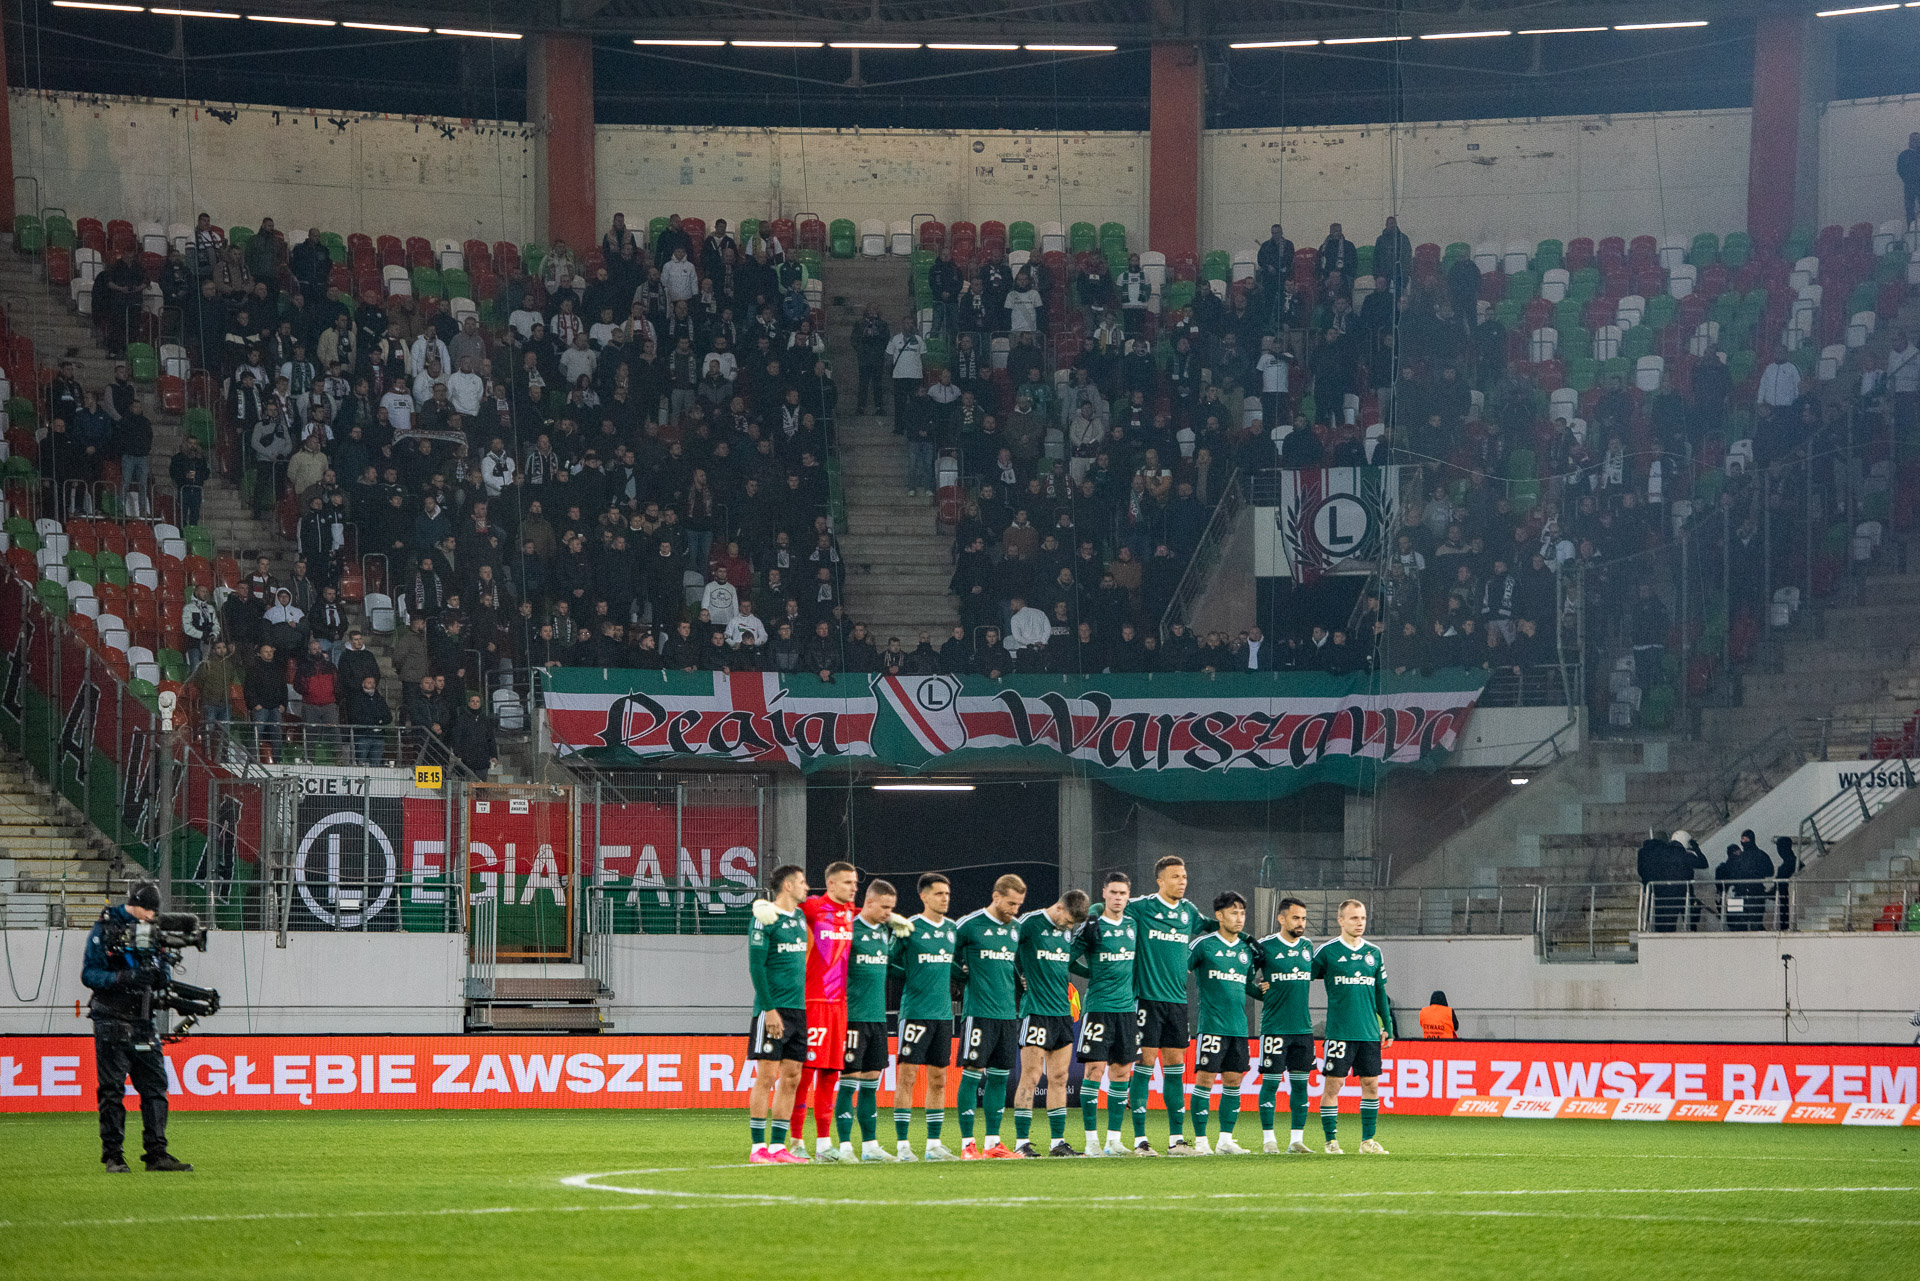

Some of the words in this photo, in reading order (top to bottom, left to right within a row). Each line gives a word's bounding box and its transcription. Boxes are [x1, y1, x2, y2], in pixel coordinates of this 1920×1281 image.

[595, 688, 849, 759] Legia
[418, 772, 428, 782] BE
[431, 772, 440, 782] 15
[596, 844, 756, 908] FANS
[807, 1027, 827, 1046] 27
[847, 1030, 859, 1049] 11
[904, 1024, 926, 1043] 67
[970, 1028, 982, 1046] 8
[1026, 1027, 1047, 1046] 28
[1084, 1022, 1104, 1041] 42
[1201, 1035, 1221, 1053] 25
[1264, 1037, 1283, 1054] 82
[1327, 1040, 1346, 1059] 23
[432, 1053, 683, 1093] ZAWSZE
[1489, 1060, 1707, 1100] ZAWSZE
[1723, 1063, 1918, 1104] RAZEM
[1458, 1100, 1499, 1113] STIHL
[1512, 1101, 1553, 1112] STIHL
[1565, 1101, 1607, 1114] STIHL
[1621, 1102, 1662, 1114] STIHL
[1676, 1104, 1719, 1117] STIHL
[1734, 1104, 1778, 1117] STIHL
[1791, 1106, 1836, 1119] STIHL
[1852, 1108, 1896, 1119] STIHL
